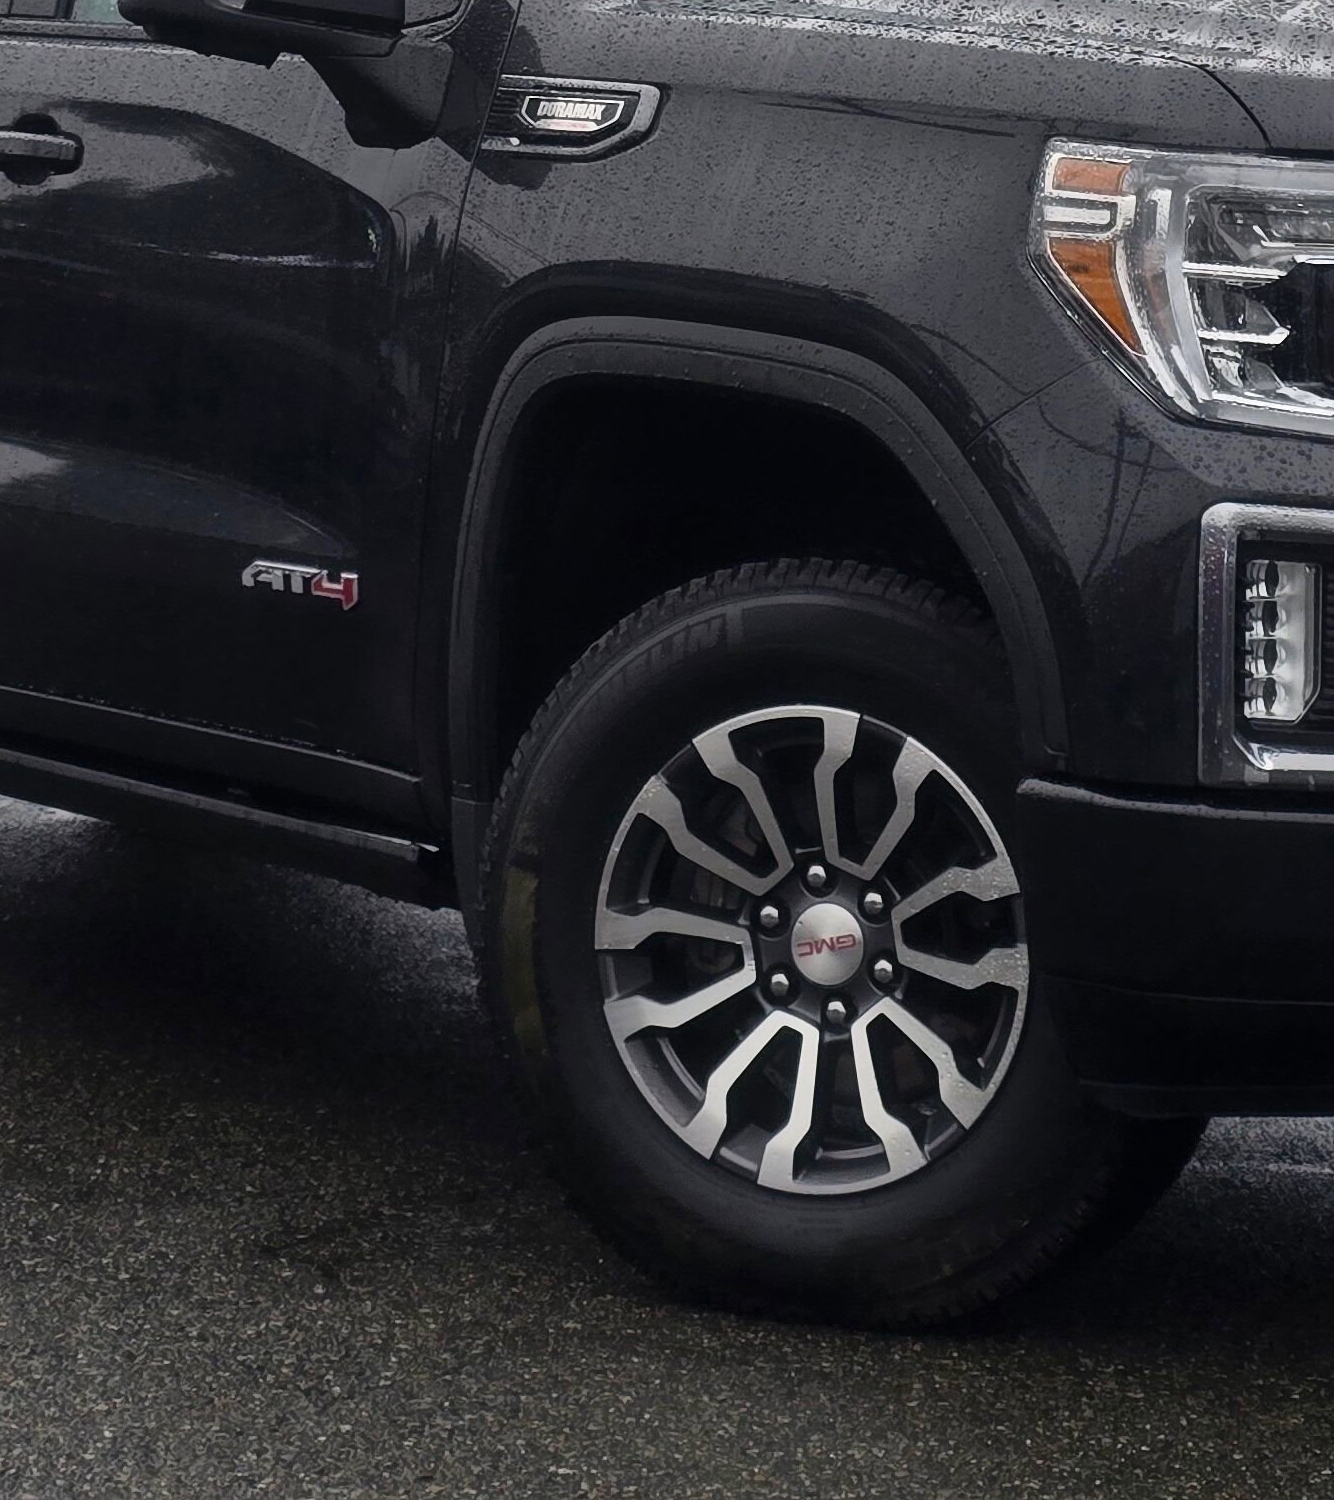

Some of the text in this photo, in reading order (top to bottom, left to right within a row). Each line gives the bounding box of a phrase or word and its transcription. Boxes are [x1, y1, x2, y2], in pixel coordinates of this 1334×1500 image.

[536, 100, 607, 121] DURAMAX
[242, 560, 359, 611] AT4
[796, 933, 857, 958] GMC
